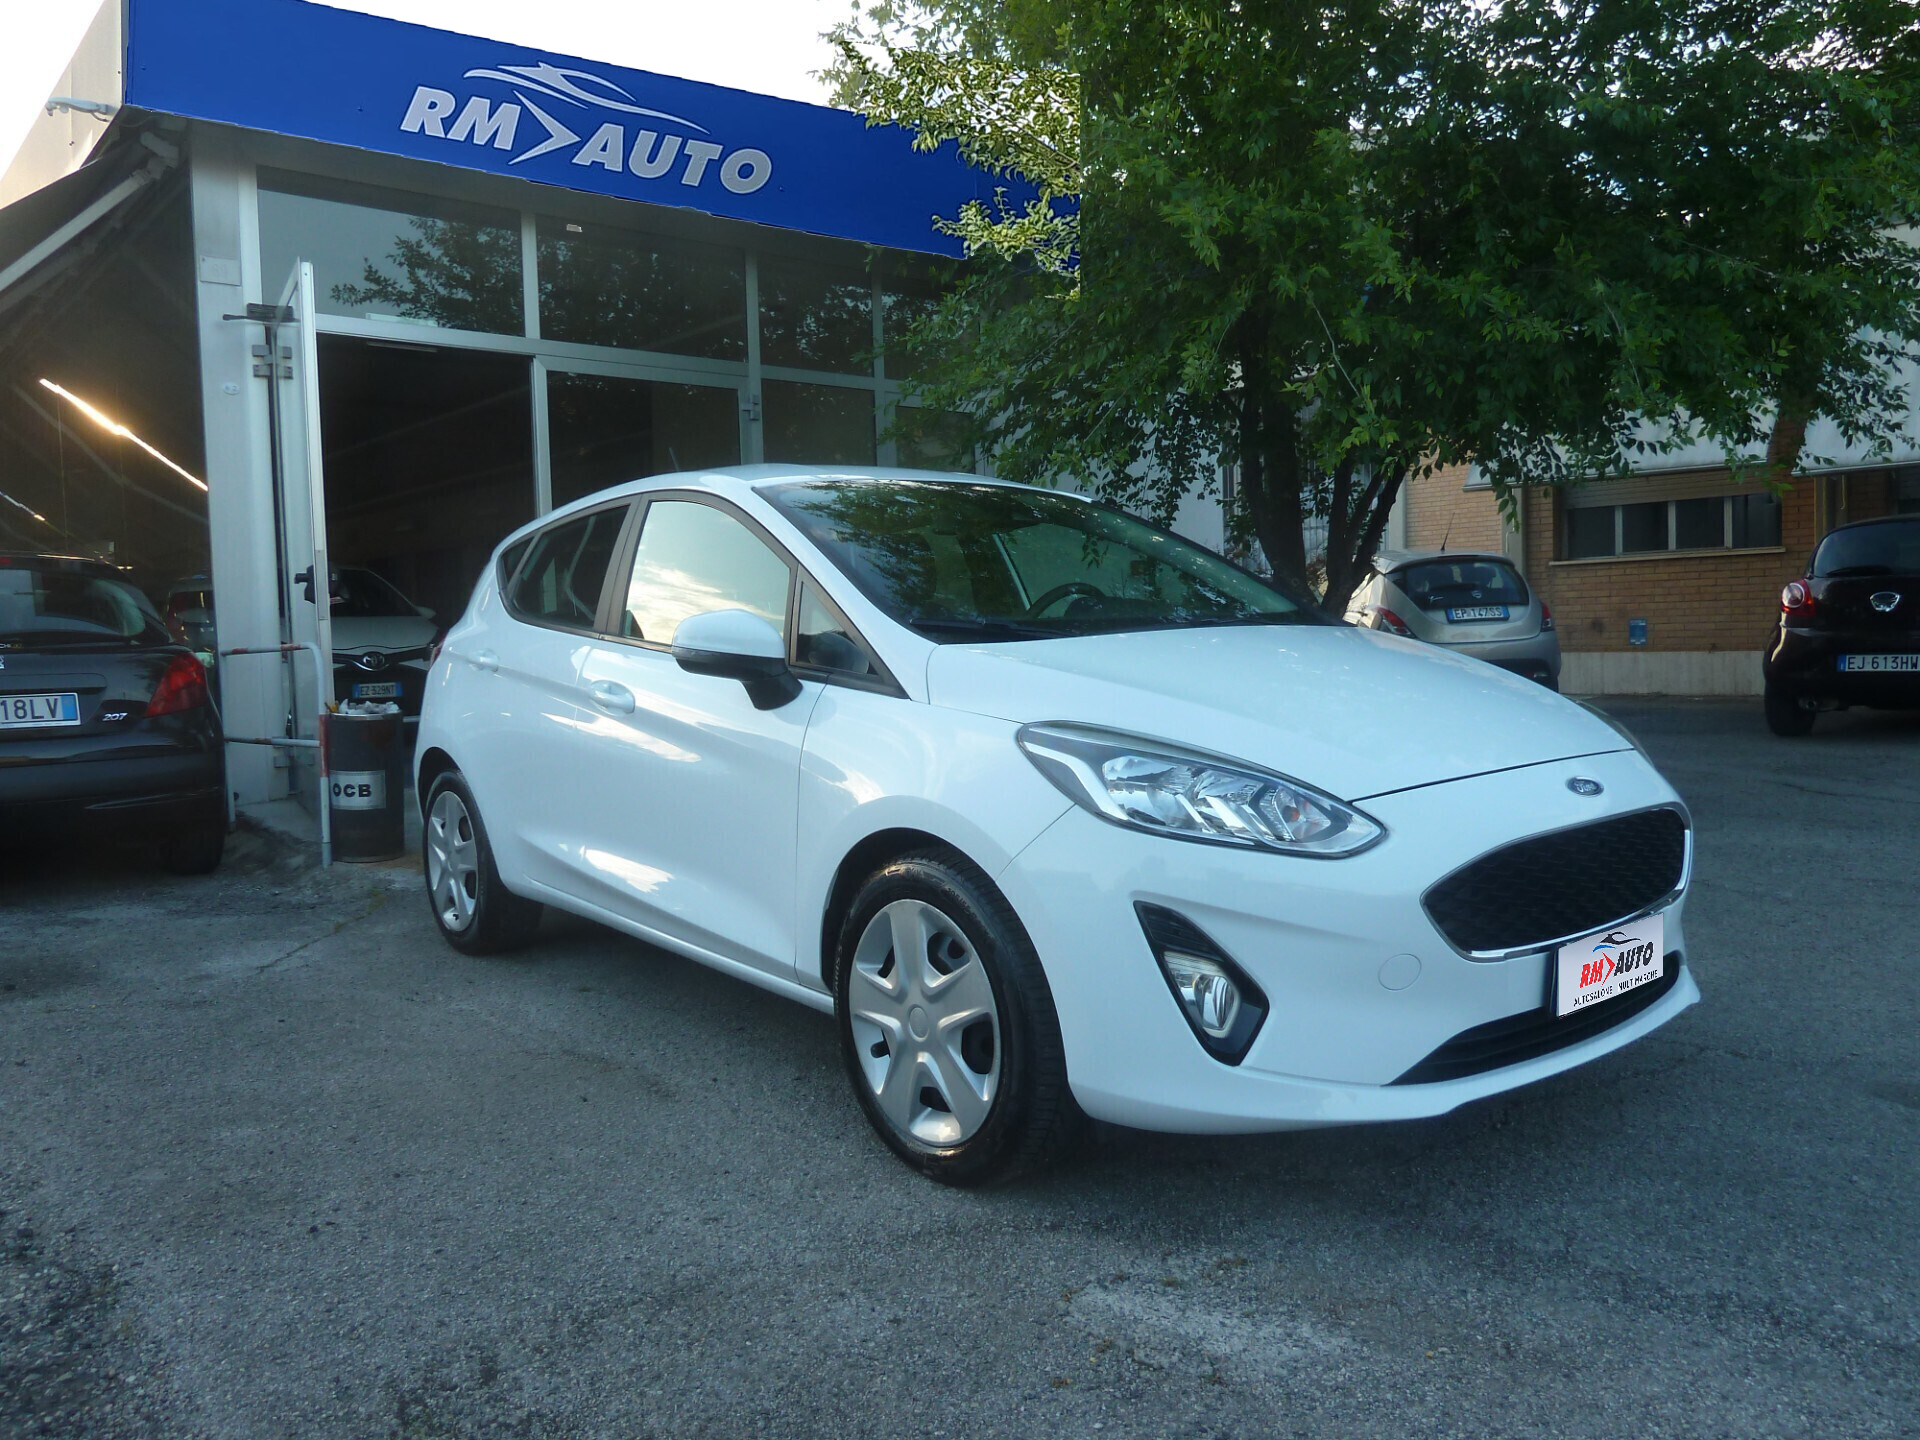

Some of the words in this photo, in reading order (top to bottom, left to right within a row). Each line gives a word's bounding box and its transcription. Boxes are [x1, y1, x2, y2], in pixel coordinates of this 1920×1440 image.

[400, 86, 521, 150] RM
[571, 123, 772, 194] AUTO
[1454, 609, 1467, 618] EP
[1847, 656, 1865, 670] EJ
[1871, 656, 1919, 670] 613HW
[0, 698, 59, 720] 18LV
[102, 712, 128, 721] 207
[332, 783, 372, 798] OCB
[1580, 958, 1604, 988] RM
[1613, 941, 1654, 977] AUTO
